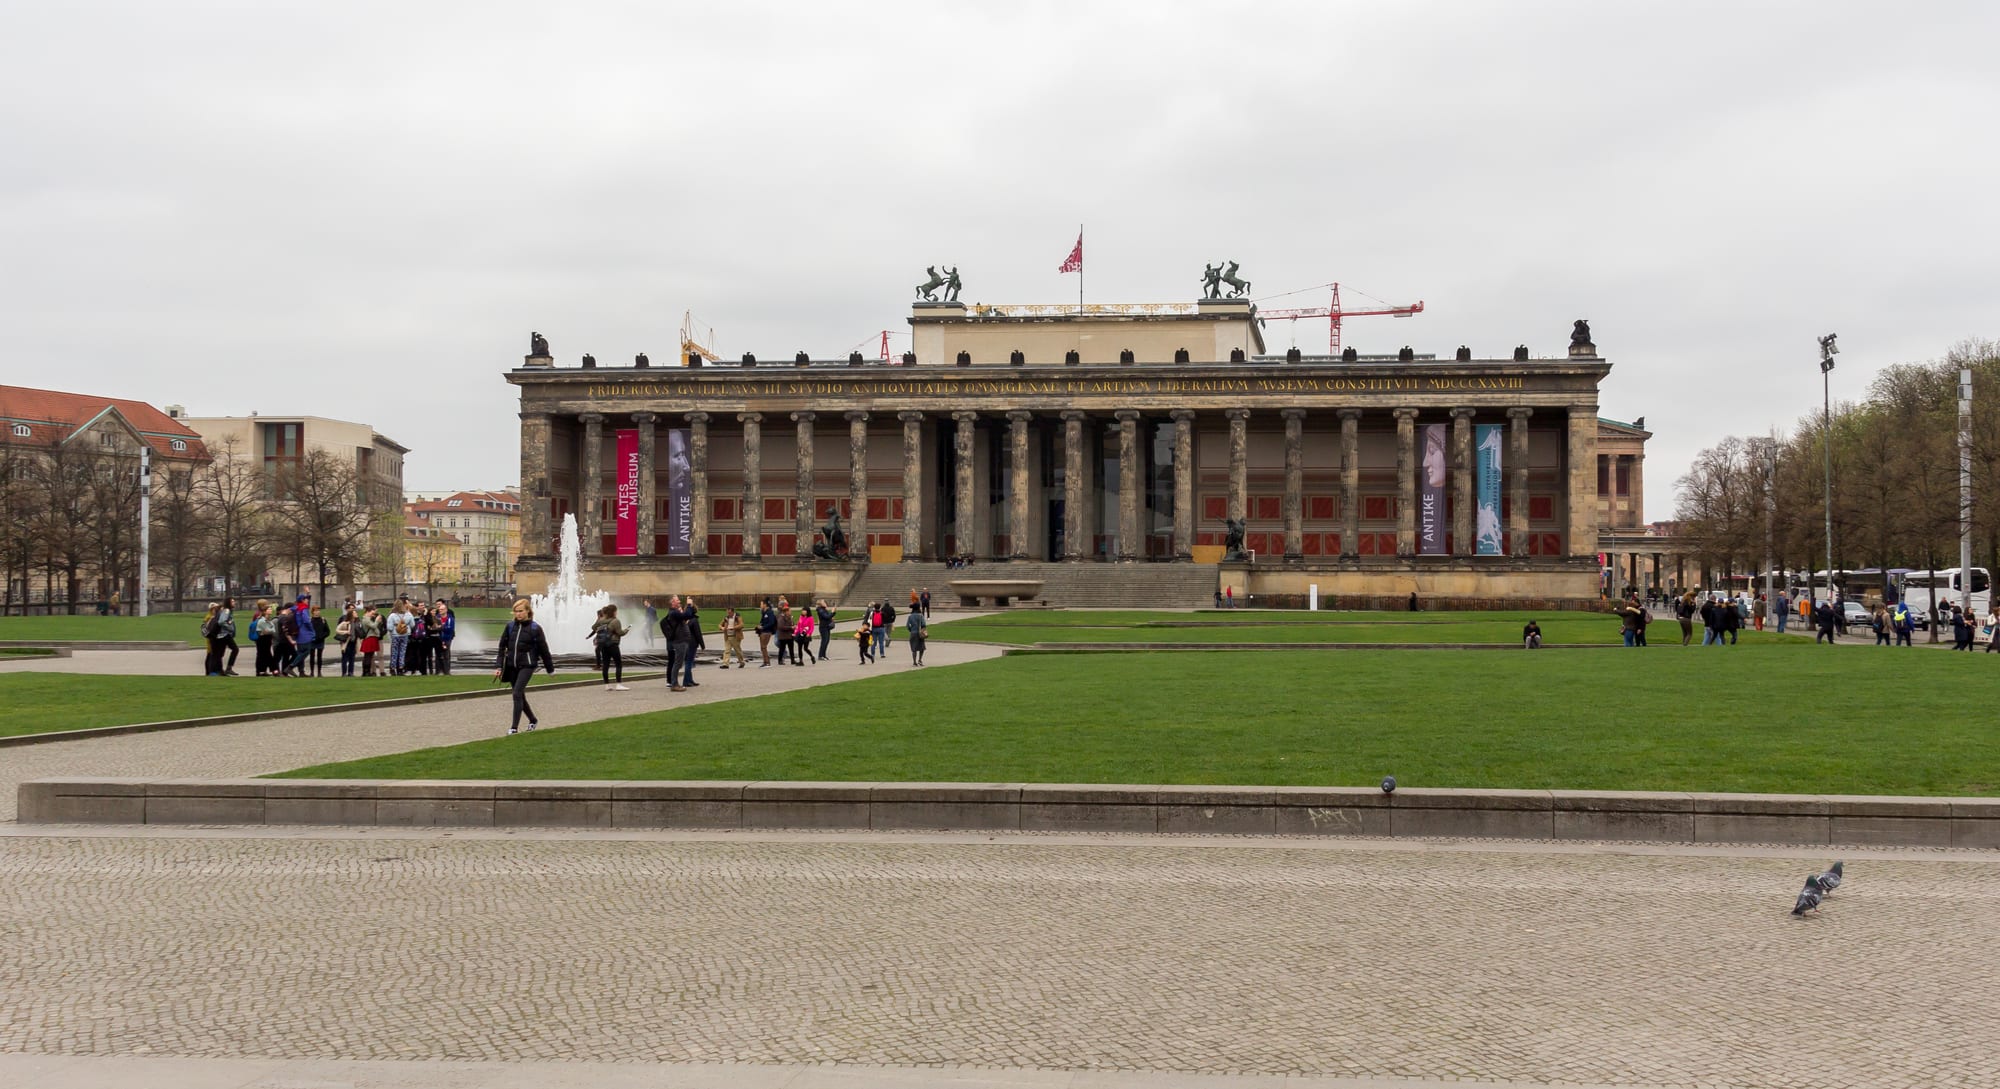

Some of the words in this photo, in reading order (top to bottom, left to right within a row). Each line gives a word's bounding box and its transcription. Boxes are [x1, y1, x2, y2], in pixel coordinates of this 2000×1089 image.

[588, 383, 670, 396] FRIDERICVS
[765, 383, 780, 395] III
[788, 383, 843, 394] STVDIO
[851, 383, 959, 395] ANTIQVITATIS
[965, 382, 1061, 394] OMNIGENAE
[1067, 381, 1086, 393] ET
[1091, 381, 1150, 393] ARTIVM
[1157, 380, 1249, 392] LIBERALIVM
[1256, 379, 1319, 391] MVSEVM
[1326, 378, 1419, 390] CONSTITVIT
[1426, 377, 1523, 390] MDCCCXXVIII
[618, 483, 629, 520] ALTES
[629, 452, 639, 506] MUSEUM
[680, 496, 690, 542] ANTIKE
[1423, 493, 1434, 542] ANTIKE
